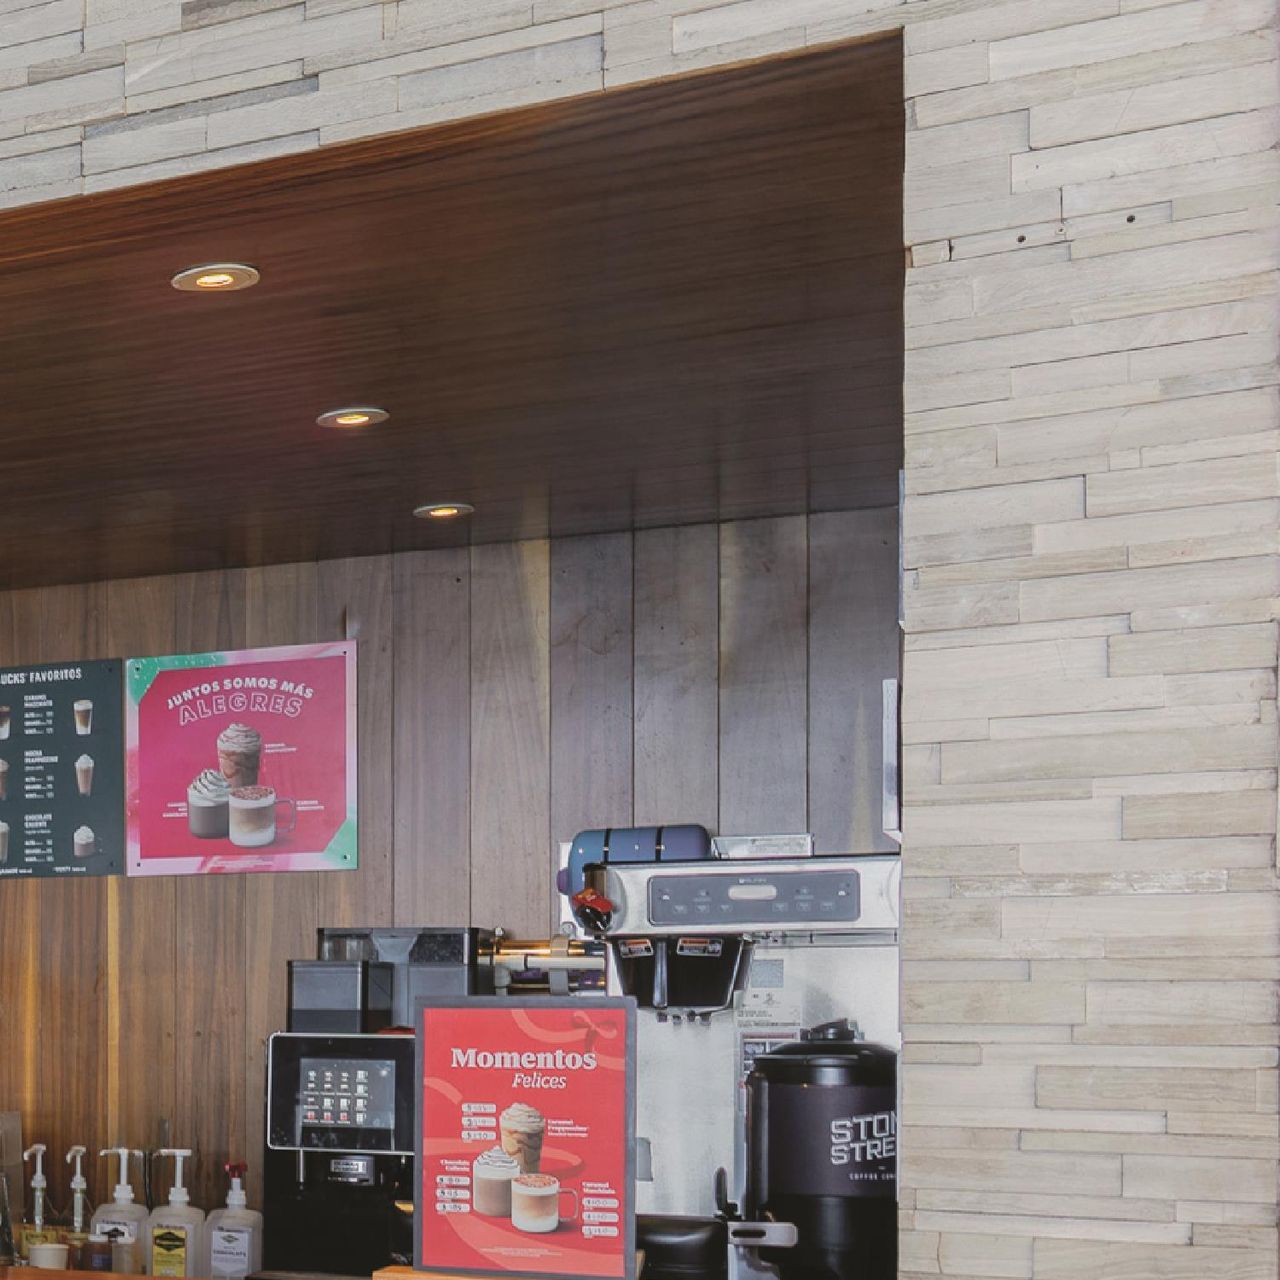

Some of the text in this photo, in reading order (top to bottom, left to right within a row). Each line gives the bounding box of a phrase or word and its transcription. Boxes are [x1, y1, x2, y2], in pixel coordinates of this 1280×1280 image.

[30, 668, 82, 683] FAVORITOS
[168, 678, 314, 709] JUNTOS SOMOS MÁS
[179, 693, 303, 726] ALEGRES
[451, 1048, 597, 1070] Momentos
[512, 1073, 566, 1089] Felices
